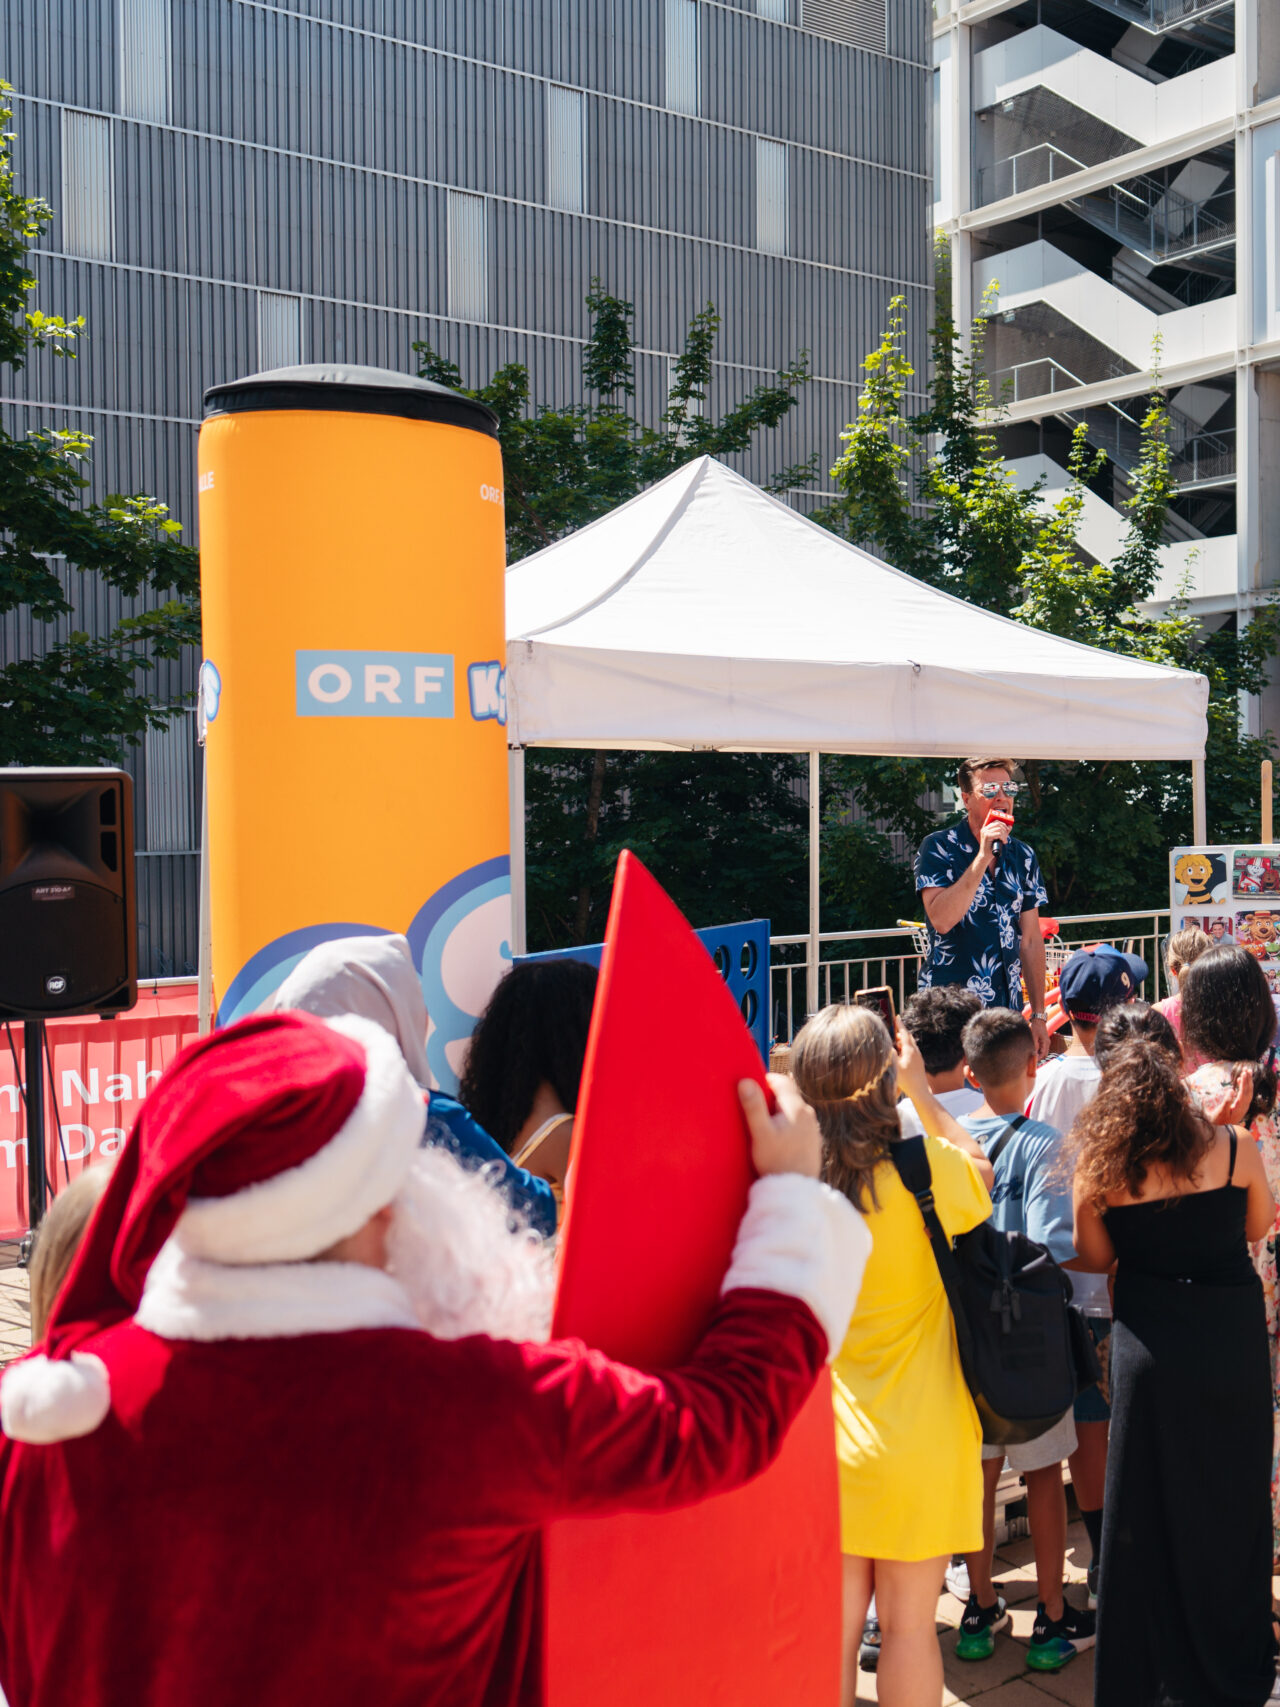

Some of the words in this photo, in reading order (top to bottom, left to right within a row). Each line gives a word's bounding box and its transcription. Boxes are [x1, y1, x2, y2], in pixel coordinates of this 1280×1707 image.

[308, 663, 445, 704] ORF
[1121, 971, 1131, 989] 9
[59, 1123, 134, 1162] Da
